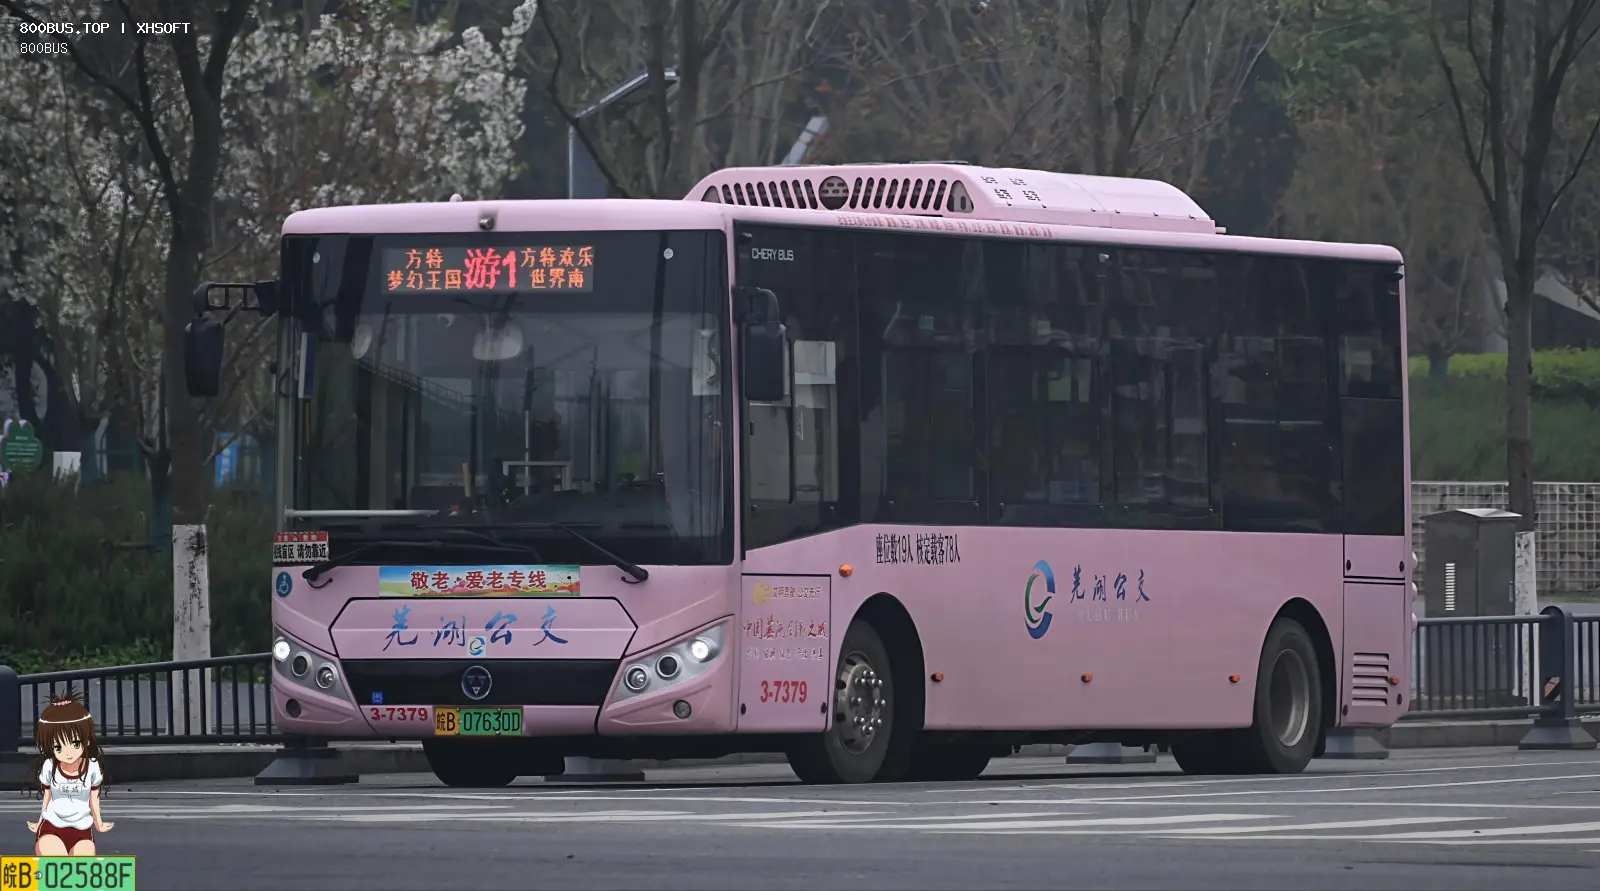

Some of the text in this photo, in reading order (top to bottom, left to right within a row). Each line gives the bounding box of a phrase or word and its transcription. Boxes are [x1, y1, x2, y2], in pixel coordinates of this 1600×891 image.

[405, 249, 443, 269] 方特
[520, 246, 594, 268] 方特欢乐
[751, 247, 794, 261] CHERY BUS
[463, 247, 517, 290] 游1
[530, 267, 585, 289] 世界南
[387, 269, 462, 291] 梦幻王国
[297, 543, 327, 559] 请勿靠近
[876, 532, 961, 565] 座位数19人 核定载客78人
[1069, 564, 1150, 604] 芜湖公交
[383, 604, 569, 652] 芜湖公交
[760, 680, 808, 704] 3-7379
[370, 707, 429, 722] 3-7379
[436, 711, 521, 732] 皖B 07630D
